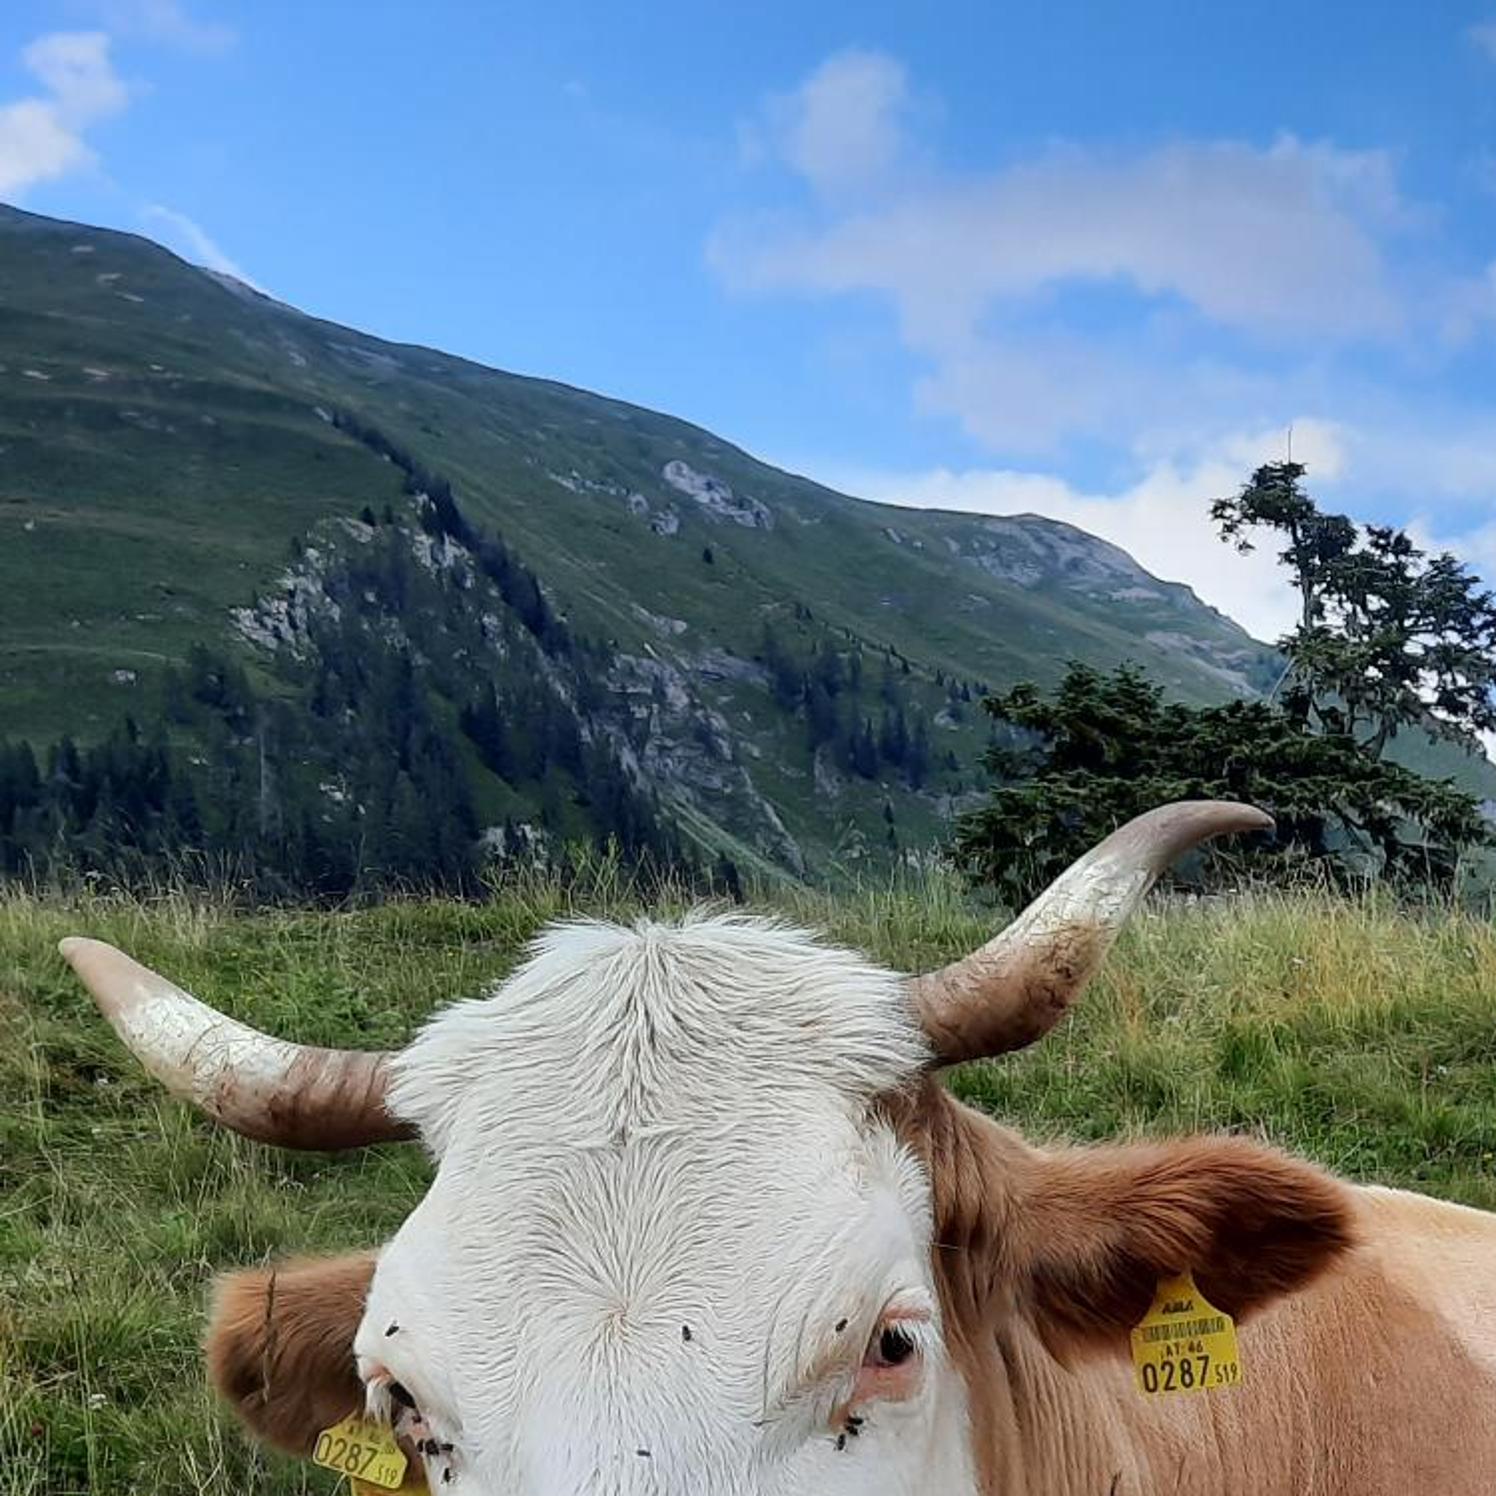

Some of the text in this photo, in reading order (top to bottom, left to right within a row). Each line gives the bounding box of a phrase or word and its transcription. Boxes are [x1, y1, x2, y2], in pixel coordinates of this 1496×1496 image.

[1142, 1355, 1238, 1393] 0287 519
[315, 1433, 379, 1475] 0287
